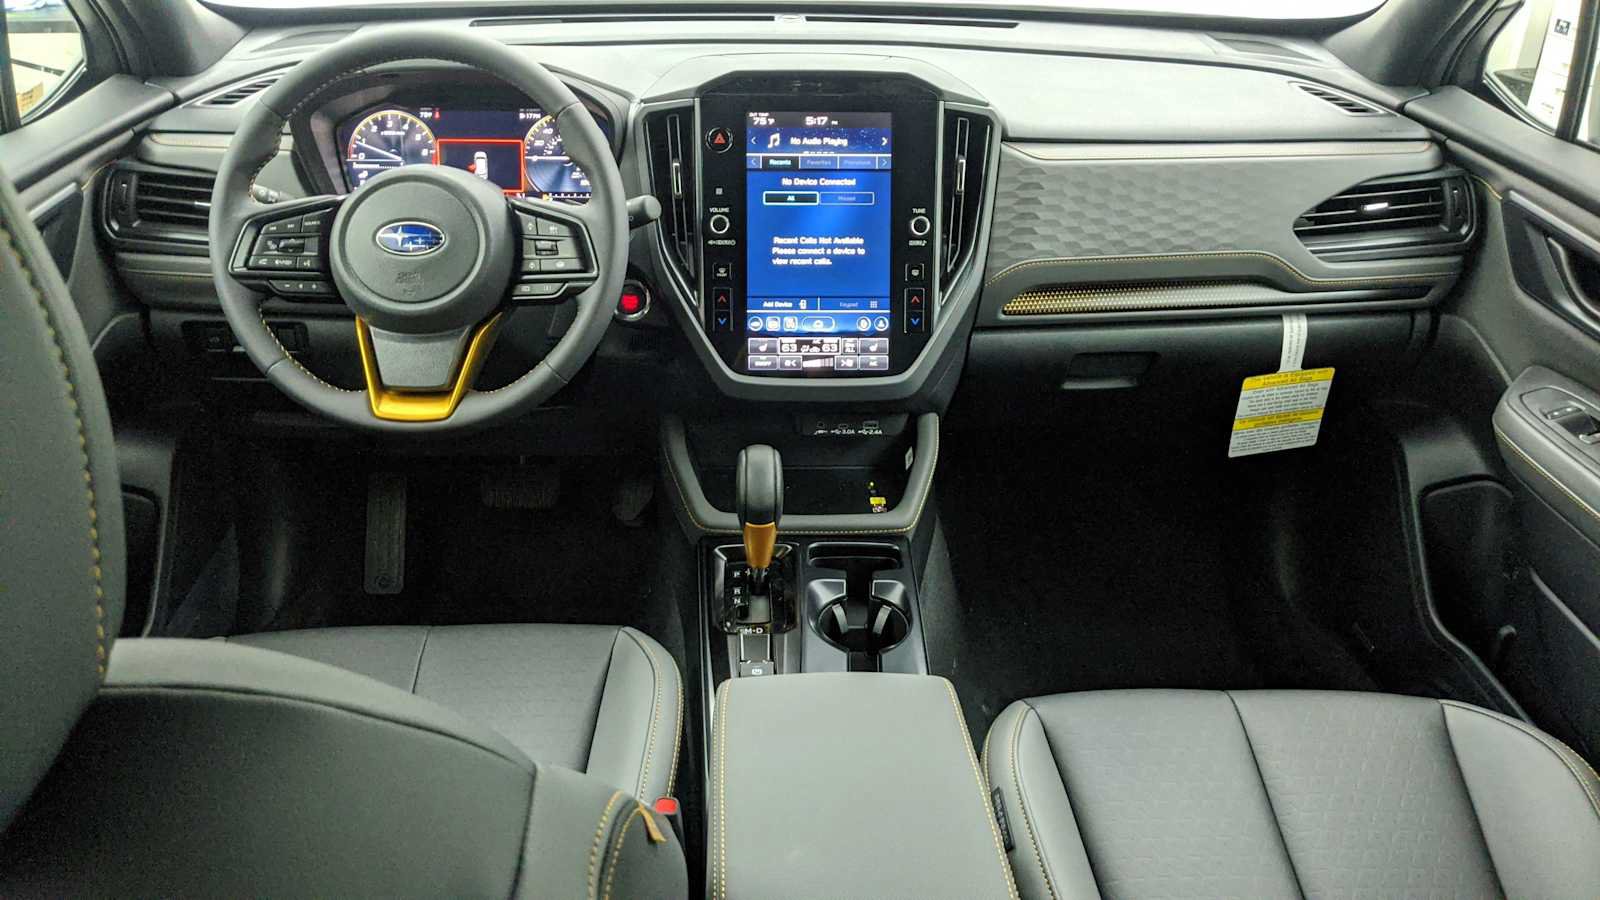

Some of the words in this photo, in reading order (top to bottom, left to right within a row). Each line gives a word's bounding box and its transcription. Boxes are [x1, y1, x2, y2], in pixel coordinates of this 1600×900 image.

[753, 116, 767, 125] 75
[805, 116, 828, 126] 5:17
[790, 137, 801, 145] No
[803, 137, 822, 145] Audio
[823, 137, 848, 147] Playing
[782, 178, 792, 186] No
[794, 178, 818, 186] Device
[819, 178, 856, 186] Connected
[773, 236, 798, 244] Recent
[800, 236, 818, 244] Calls
[819, 236, 832, 244] Not
[833, 236, 864, 244] Available
[772, 247, 796, 255] Please
[797, 247, 826, 255] connect
[833, 247, 856, 255] device
[782, 343, 798, 353] 63
[822, 343, 838, 353] 63
